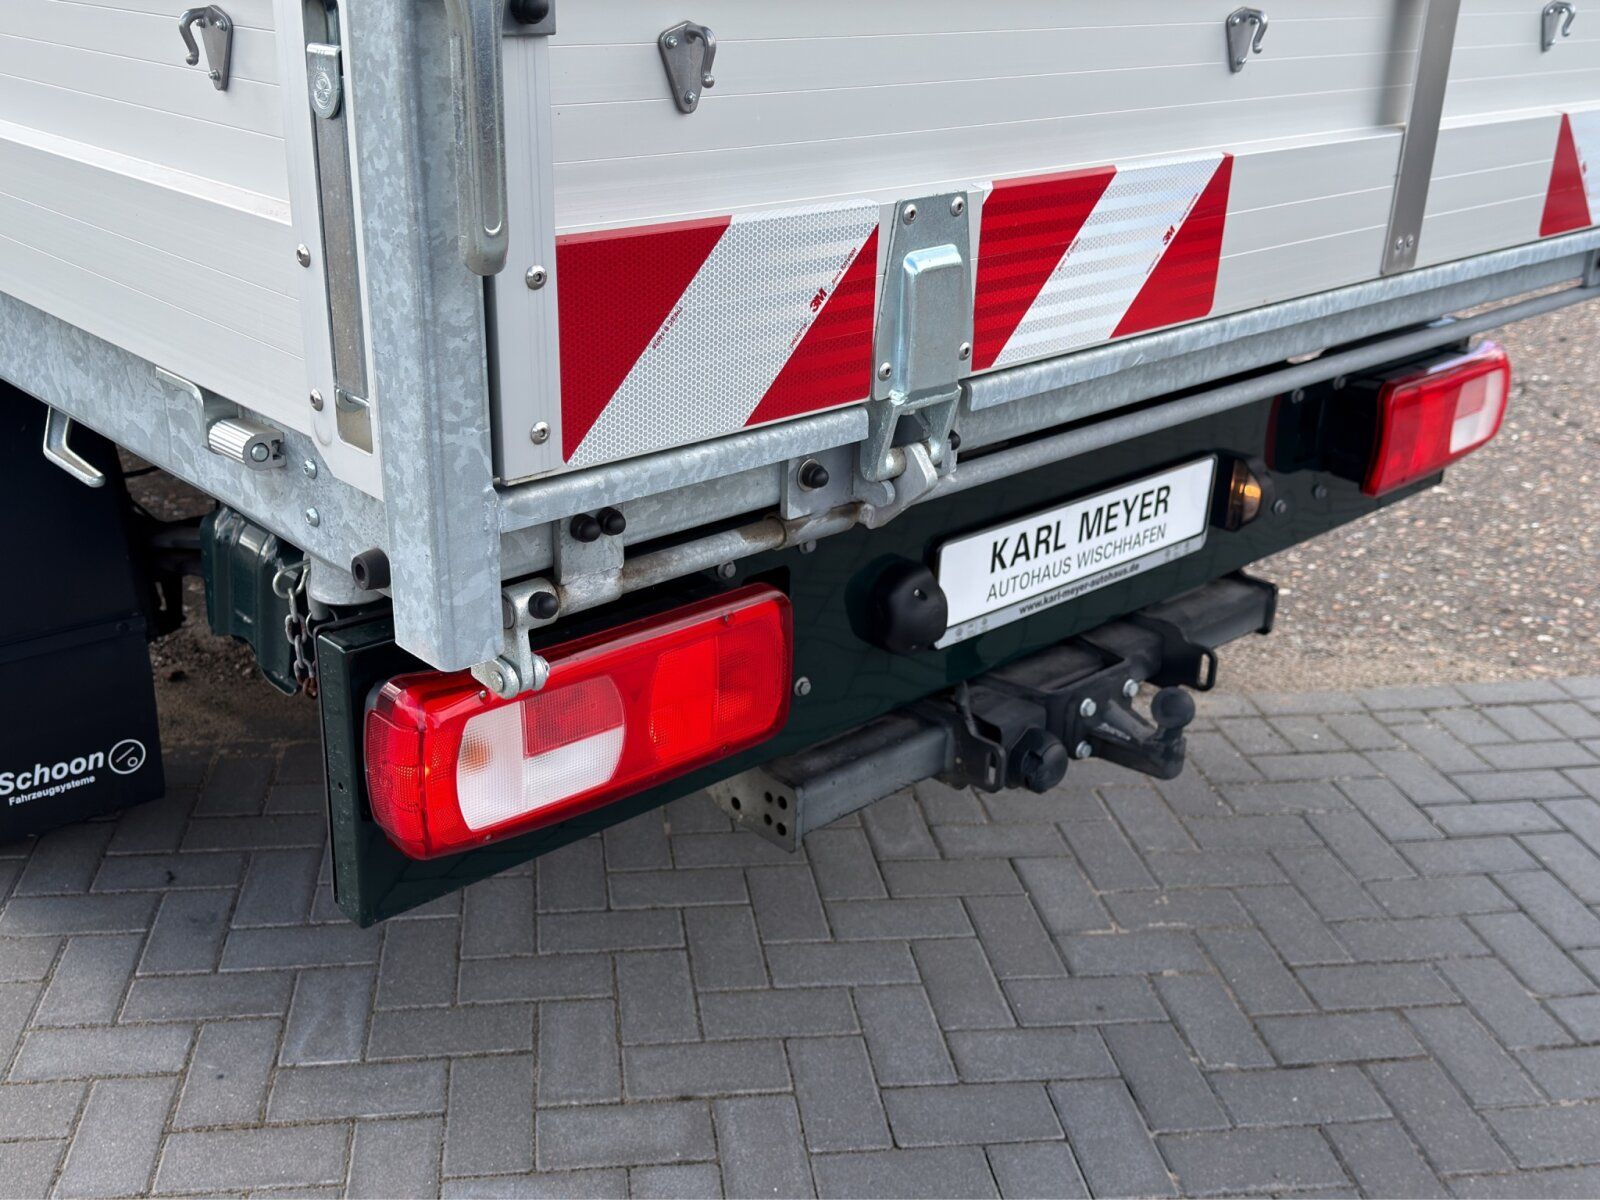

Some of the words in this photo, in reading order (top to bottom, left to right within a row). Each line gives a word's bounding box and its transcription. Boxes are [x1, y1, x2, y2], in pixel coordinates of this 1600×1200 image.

[1163, 225, 1175, 245] 3M
[810, 287, 827, 312] 3M
[990, 520, 1066, 573] KARL
[1078, 485, 1171, 543] MEYER
[986, 557, 1071, 602] AUTOHAUS
[1077, 523, 1167, 568] WISCHHAFEN
[1018, 563, 1140, 615] www.karl-meyer-autohaus.de
[0, 751, 104, 795] Schoon
[8, 775, 96, 806] Fahrzeugsysteme
